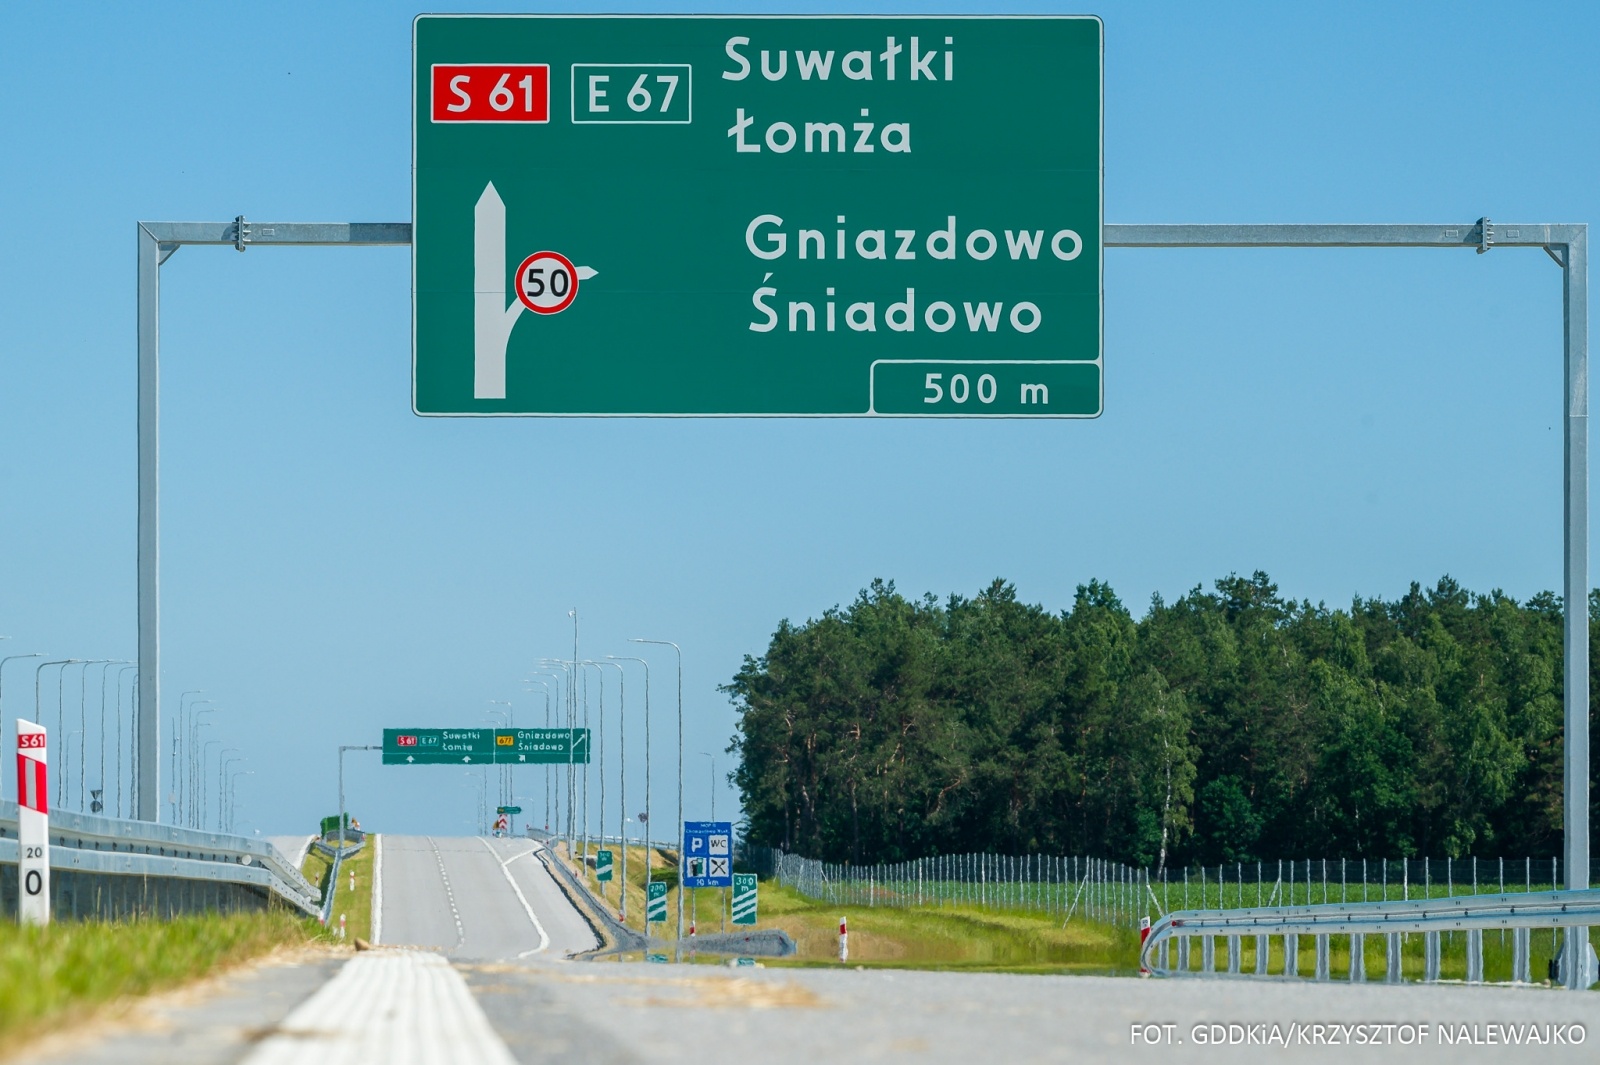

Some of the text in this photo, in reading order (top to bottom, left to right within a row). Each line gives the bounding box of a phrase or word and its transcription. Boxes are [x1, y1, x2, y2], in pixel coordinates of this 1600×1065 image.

[722, 37, 952, 81] Suwałki
[447, 74, 532, 112] S 61
[589, 74, 678, 112] E 67
[728, 109, 911, 153] Łomża
[746, 215, 1082, 260] Gniazdowo
[526, 269, 569, 299] 50
[749, 273, 1041, 333] Śniadowo
[924, 374, 1048, 404] 500 m
[442, 731, 480, 740] Suwałki
[442, 742, 473, 751] Łomża
[517, 731, 570, 739] Gniazdowo
[518, 740, 564, 751] Śniadowo
[26, 847, 42, 858] 20
[711, 839, 727, 848] WC
[25, 870, 42, 895] 0
[736, 877, 754, 885] 300
